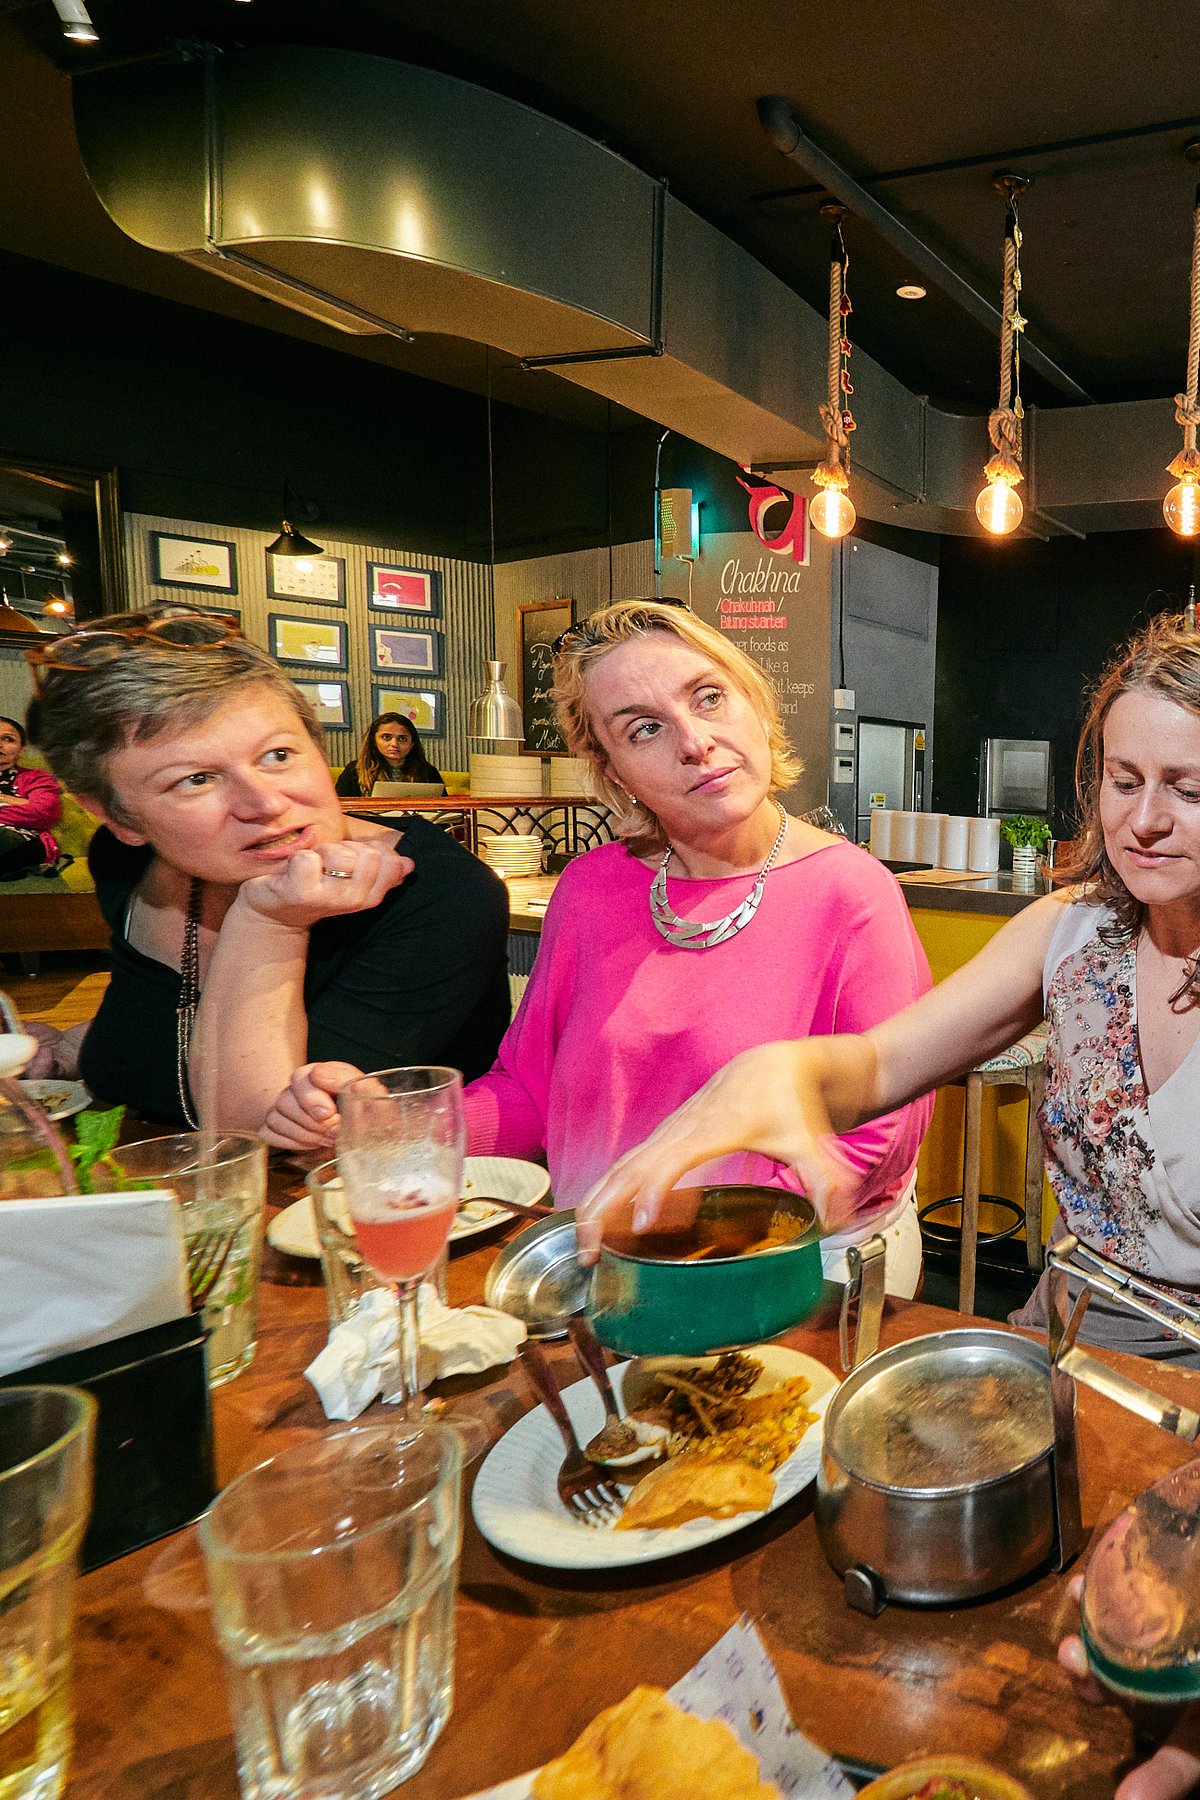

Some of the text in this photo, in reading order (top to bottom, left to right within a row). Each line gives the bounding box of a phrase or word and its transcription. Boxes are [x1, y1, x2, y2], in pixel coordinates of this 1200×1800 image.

[720, 557, 801, 594] Chakhna
[720, 615, 747, 633] Biting
[750, 636, 776, 652] foods
[777, 640, 789, 652] as
[782, 661, 789, 673] a
[786, 678, 815, 699] keeps
